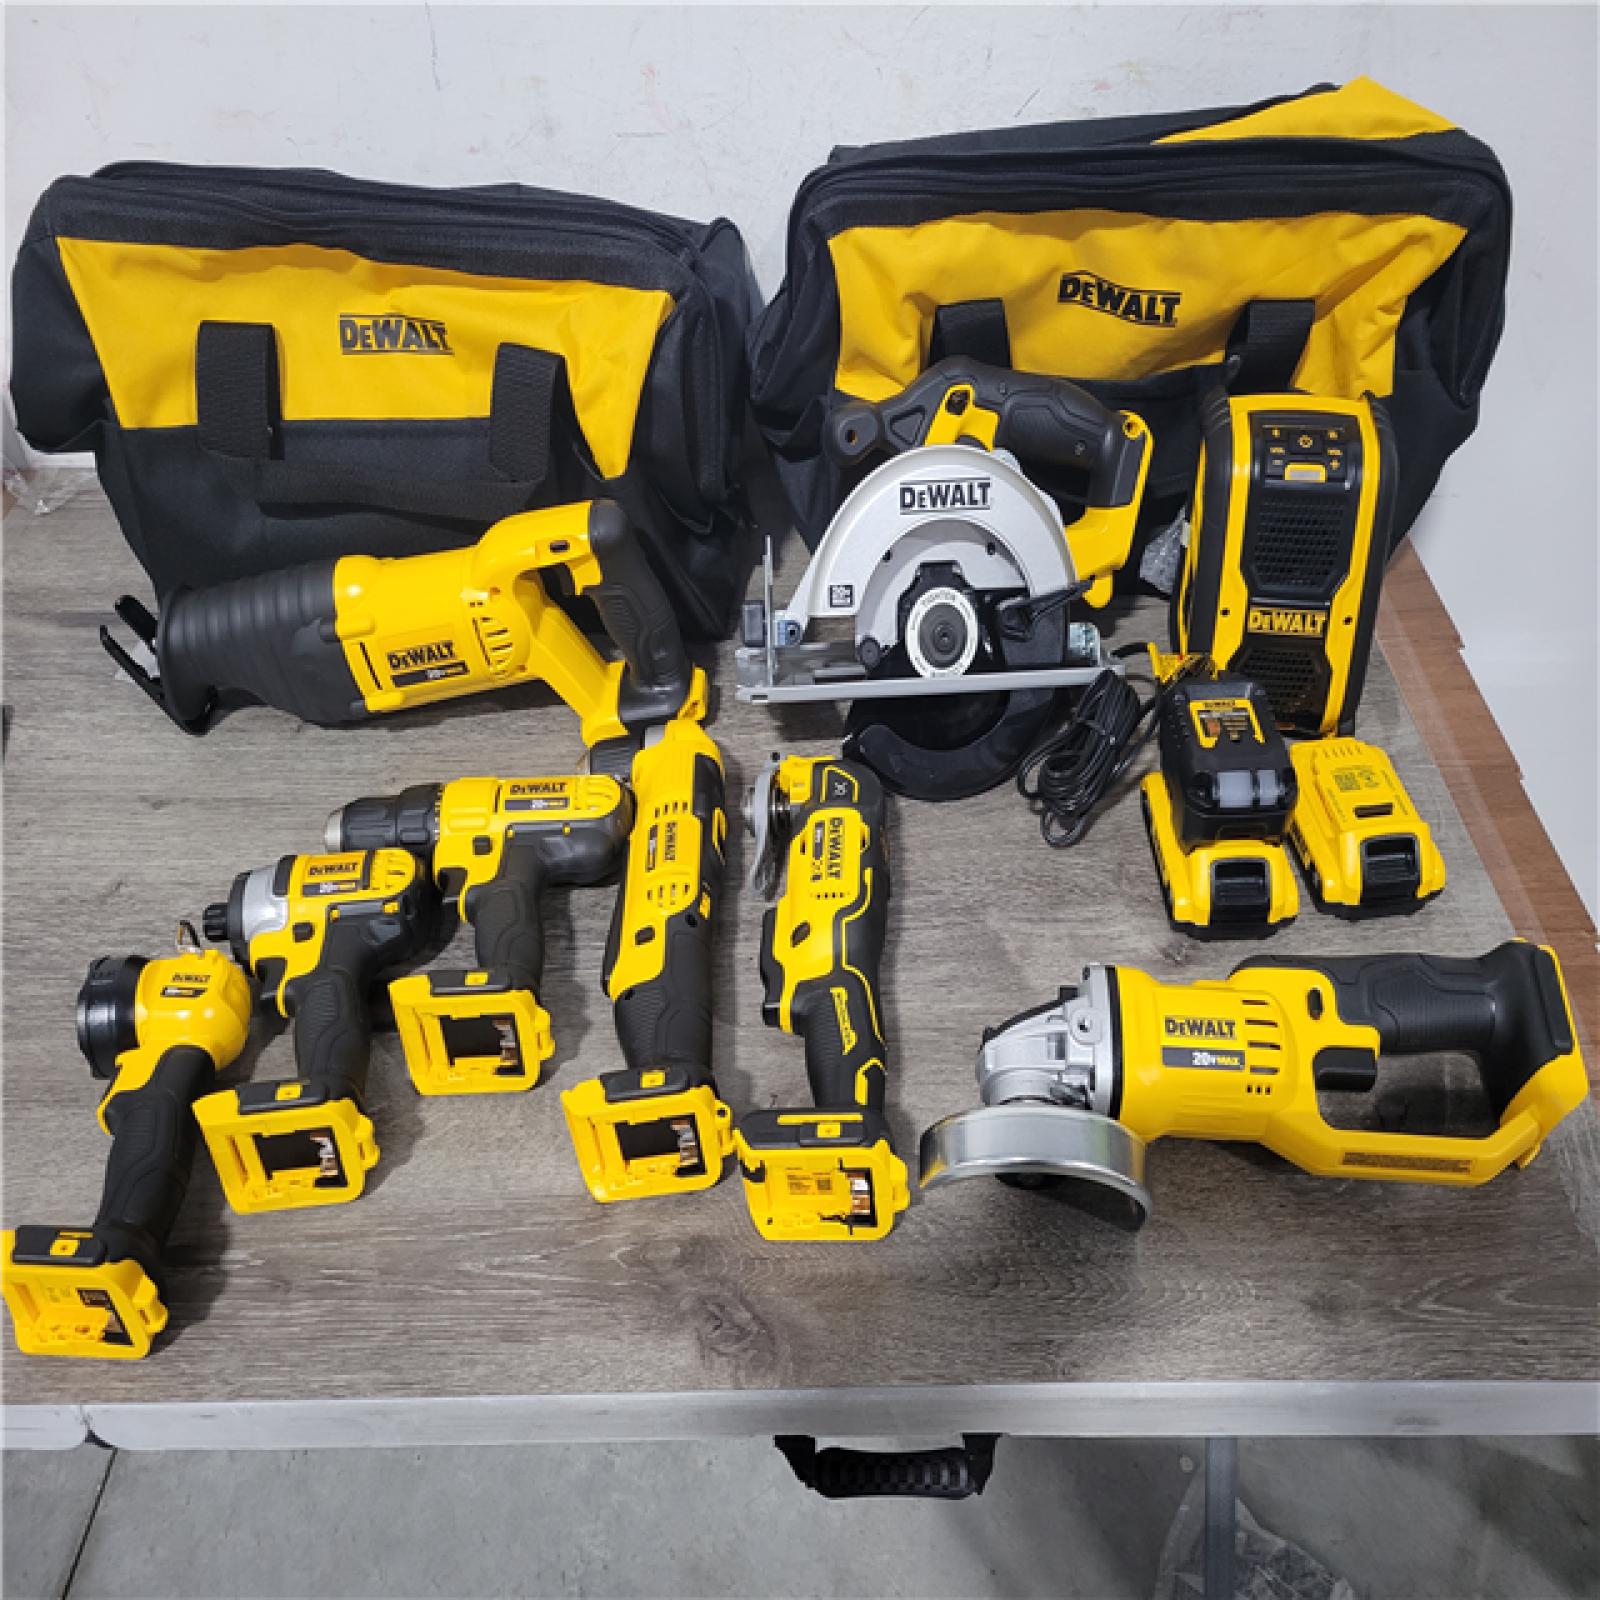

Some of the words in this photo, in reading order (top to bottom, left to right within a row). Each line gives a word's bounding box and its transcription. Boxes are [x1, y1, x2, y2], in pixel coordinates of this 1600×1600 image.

[1058, 273, 1181, 325] DEWALT
[339, 316, 449, 351] DEWALT
[899, 481, 991, 509] DEWALT
[1249, 608, 1327, 634] DEWALT
[387, 643, 454, 670] DEWALT
[510, 782, 567, 795] DEWALT
[664, 821, 677, 861] DEWALT
[828, 817, 843, 879] DEWALT
[309, 862, 359, 877] DEWALT
[1164, 1017, 1236, 1037] DEWALT
